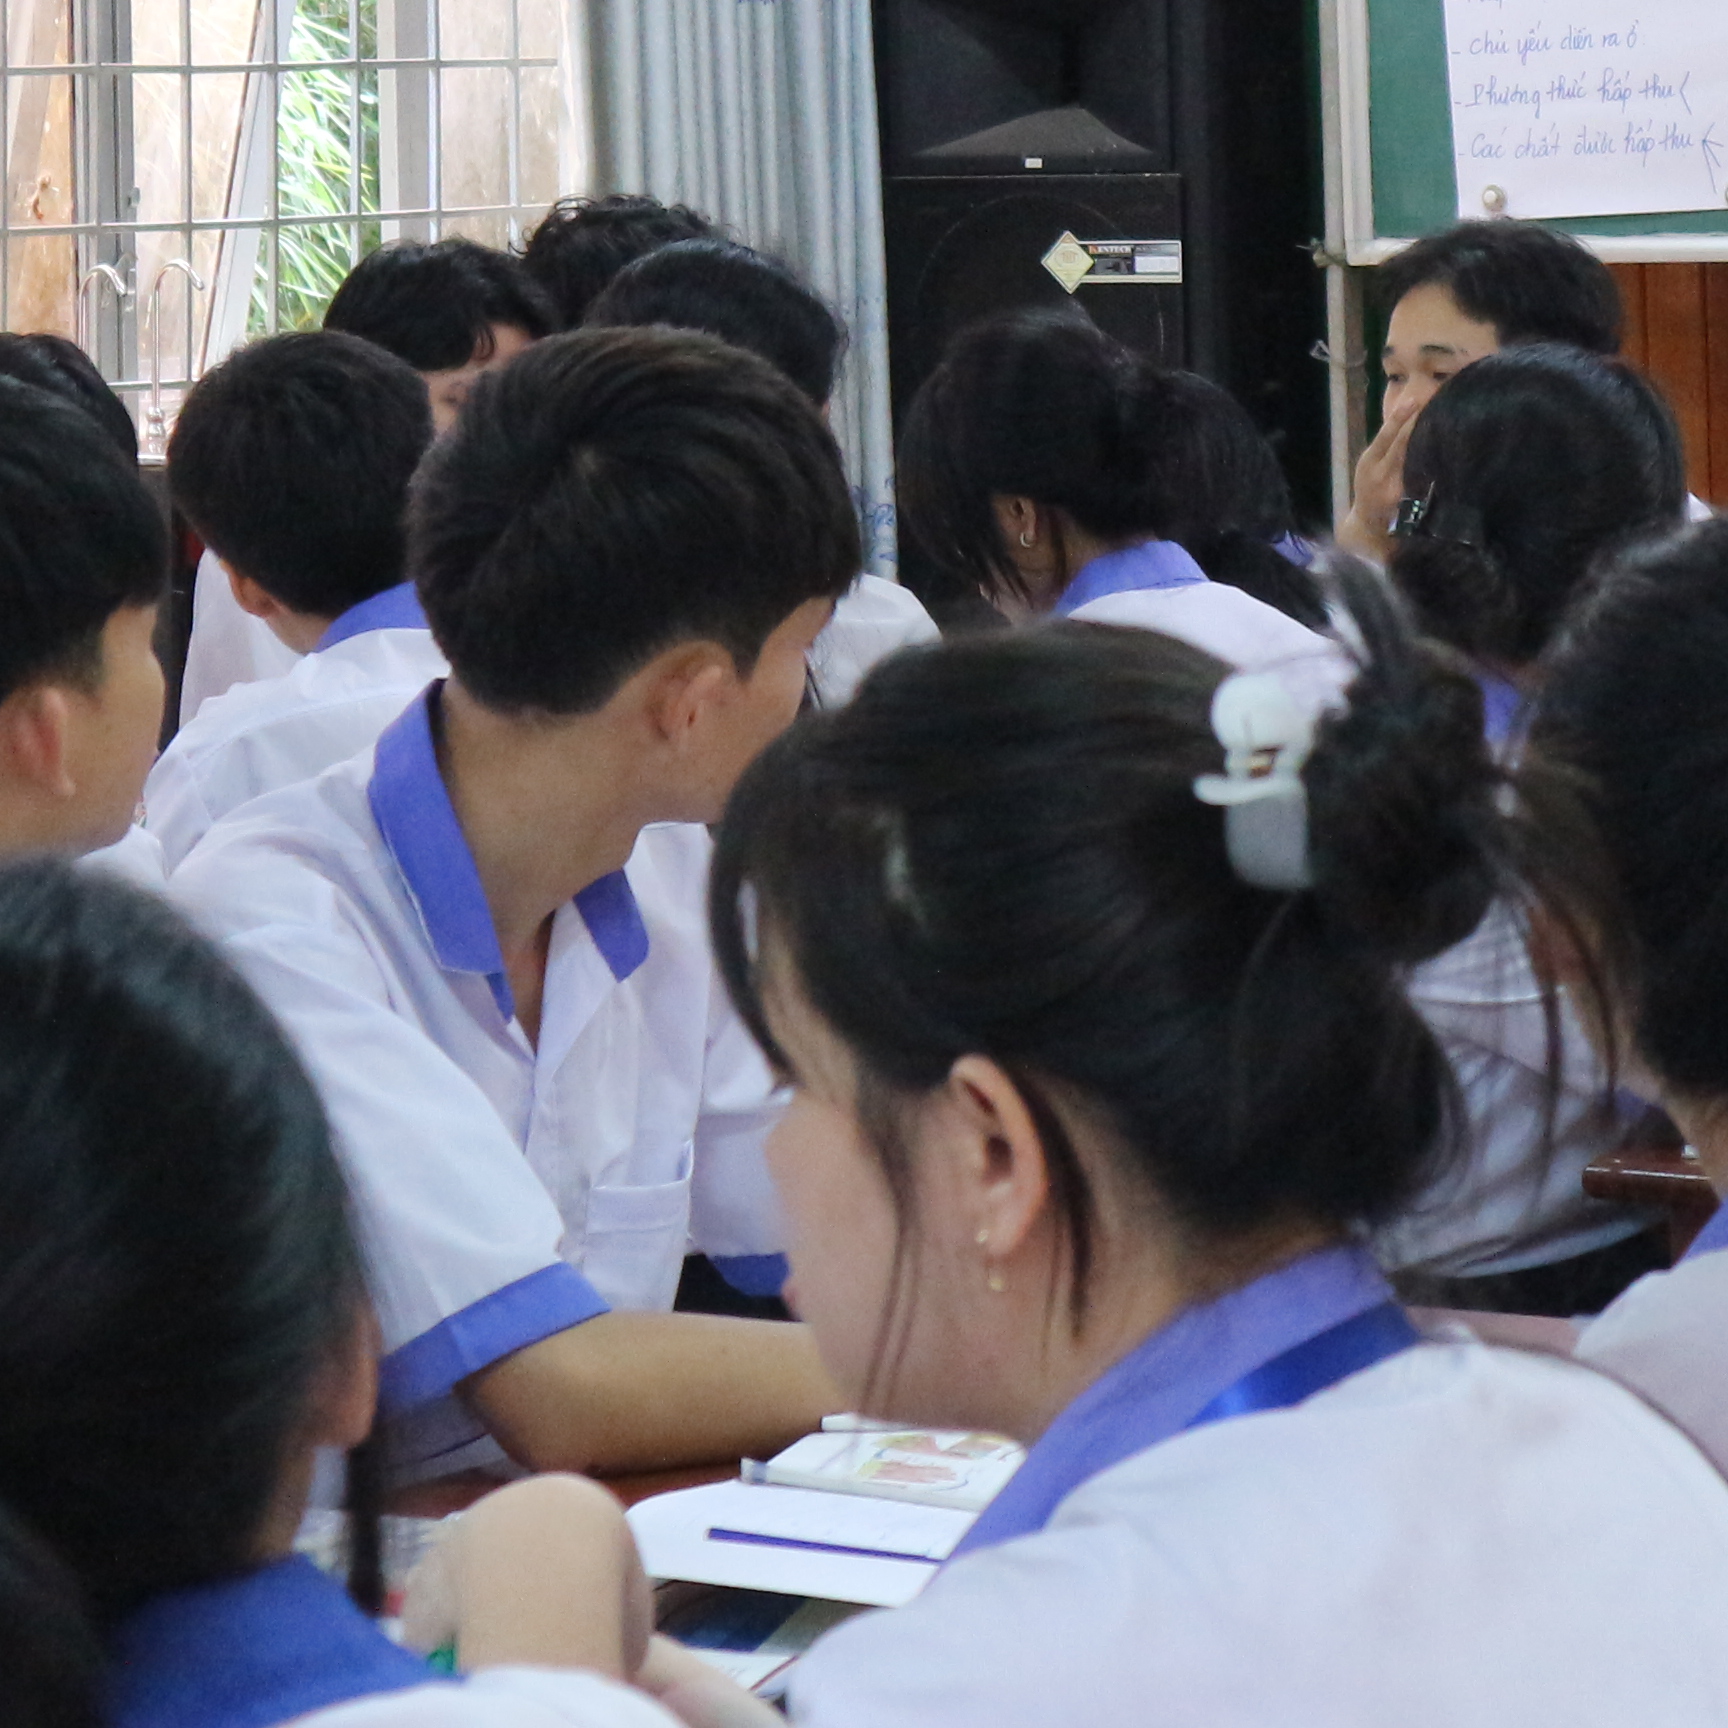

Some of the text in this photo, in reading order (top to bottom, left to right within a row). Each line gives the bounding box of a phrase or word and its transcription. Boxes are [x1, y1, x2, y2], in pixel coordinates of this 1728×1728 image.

[1517, 20, 1552, 65] yếu
[1602, 32, 1621, 48] ra
[1597, 67, 1632, 113] hấp
[1471, 126, 1507, 159] Các
[1514, 122, 1561, 159] chất
[1625, 118, 1655, 168] hấp
